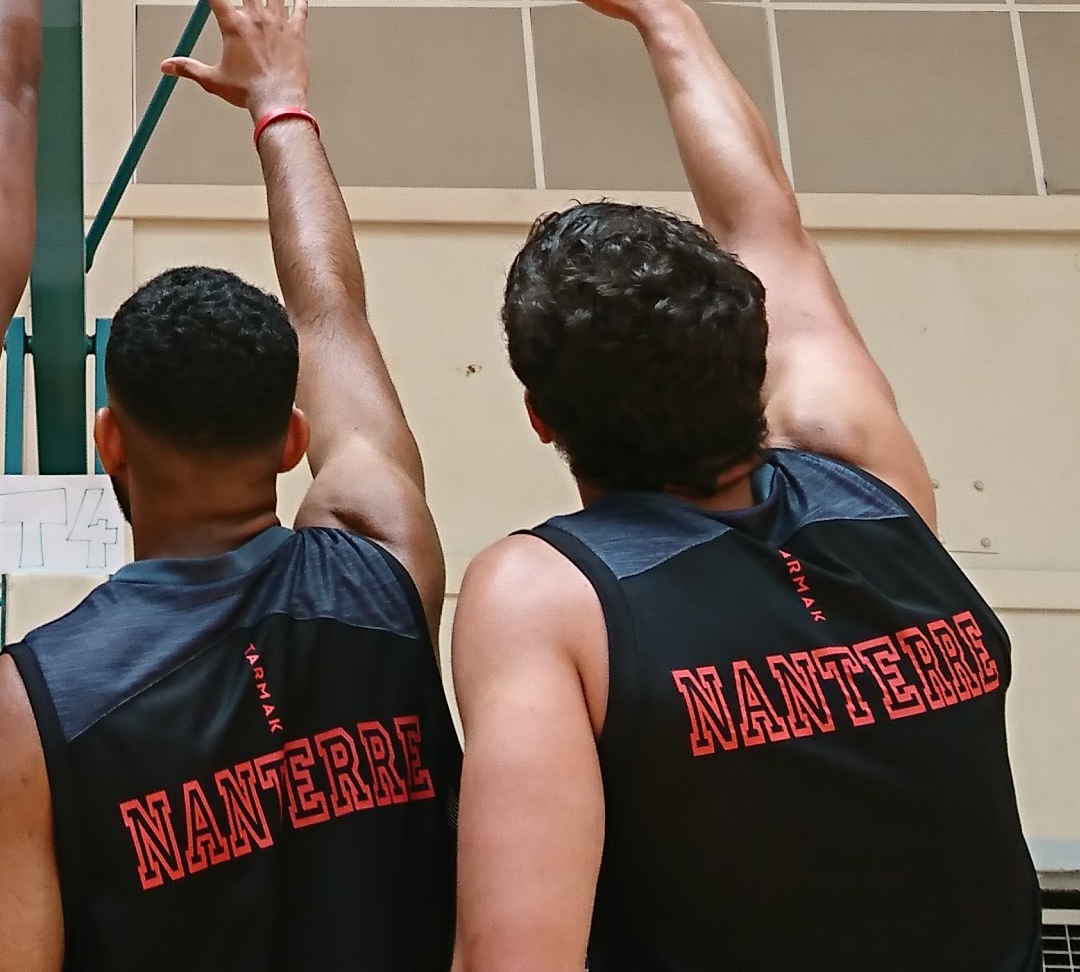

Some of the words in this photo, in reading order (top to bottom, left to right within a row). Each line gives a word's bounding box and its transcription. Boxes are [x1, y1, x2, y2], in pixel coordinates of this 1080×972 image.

[244, 643, 284, 733] TARMAK
[672, 610, 1000, 756] NANTERRE
[120, 715, 436, 891] NANTERRE
